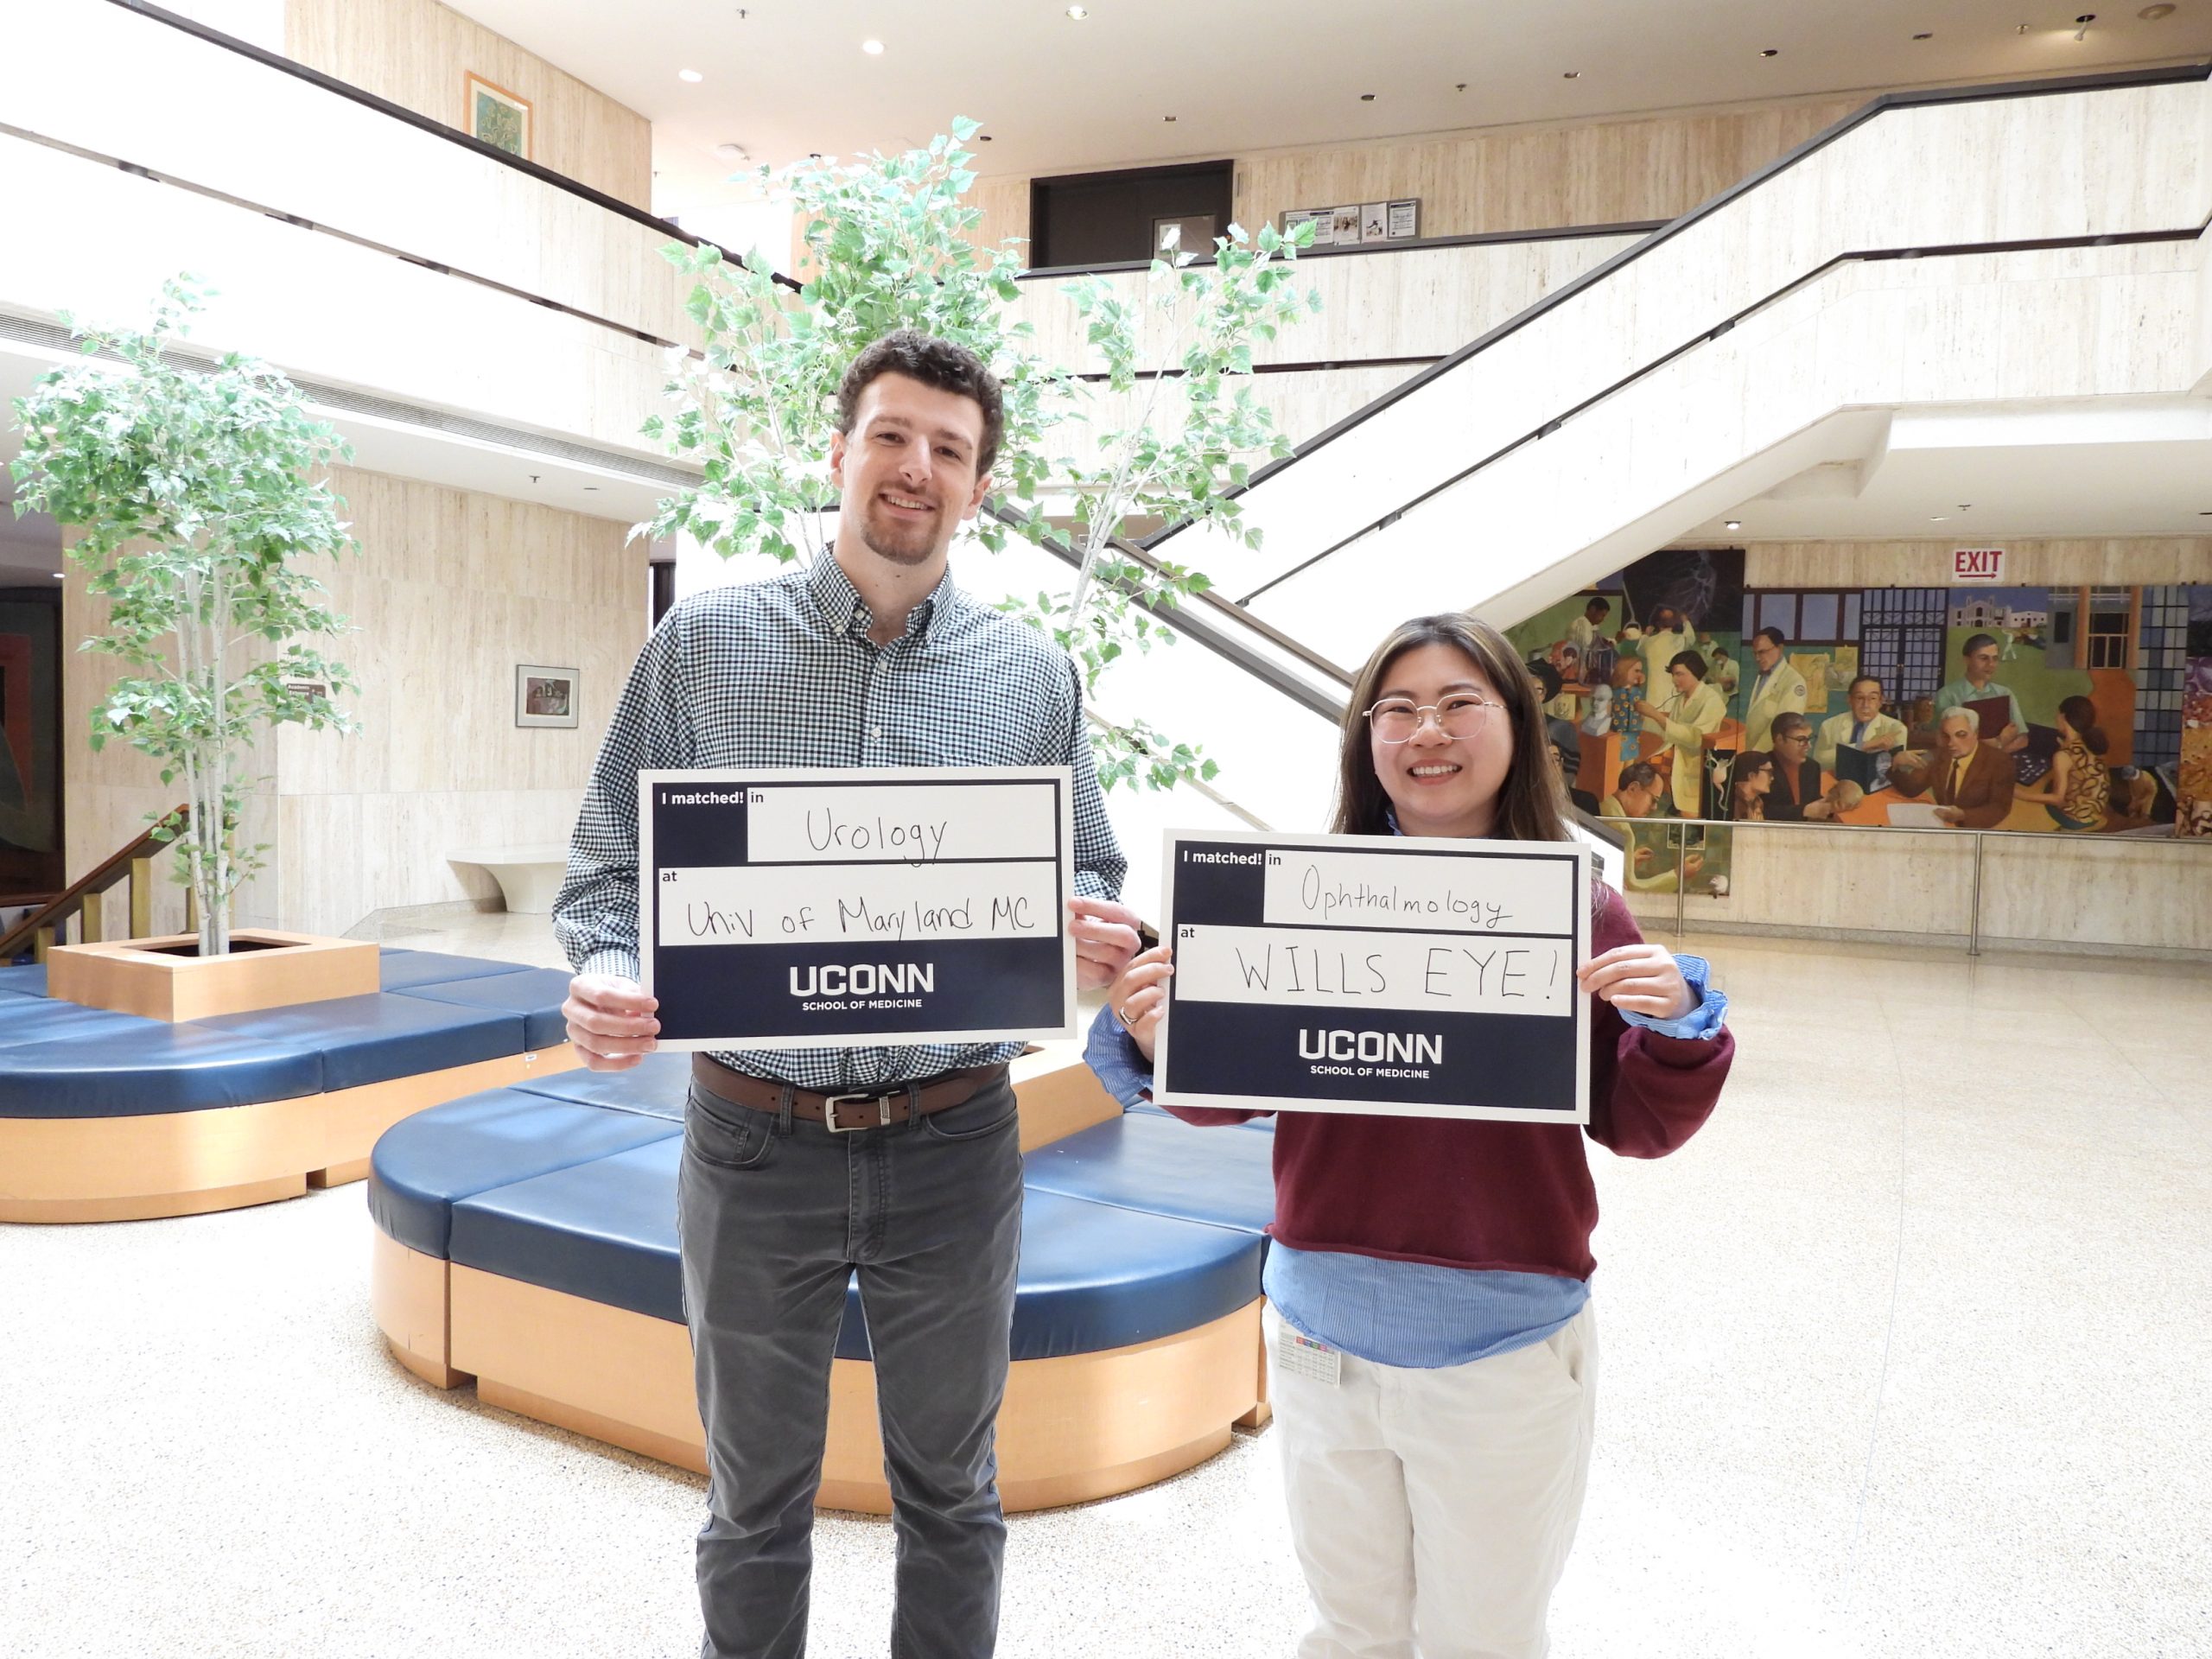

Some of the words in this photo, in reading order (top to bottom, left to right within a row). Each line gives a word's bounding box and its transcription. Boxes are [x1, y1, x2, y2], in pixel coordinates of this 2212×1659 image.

[1955, 550, 2003, 572] EXIT
[662, 792, 666, 804] I
[671, 791, 744, 804] matched!
[750, 791, 764, 804] in
[807, 808, 948, 868] Urology
[1183, 850, 1188, 862] I
[1192, 850, 1262, 866] matched!
[1268, 853, 1281, 866] in
[662, 870, 677, 882] at
[1301, 865, 1513, 928] Ophthalmology
[688, 900, 754, 938] Univ
[781, 906, 815, 933] of
[838, 896, 973, 942] Maryland
[991, 896, 1035, 931] MC
[1180, 927, 1195, 938] at
[789, 963, 934, 997] UCONN
[1236, 944, 1387, 995] WILLS
[1424, 948, 1558, 1000] EYE!
[802, 1001, 848, 1011] SCHOOL
[849, 1000, 867, 1010] OF
[868, 999, 923, 1010] MEDICINE
[1298, 1028, 1443, 1065] UCONN
[1310, 1065, 1355, 1077] SCHOOL
[1357, 1066, 1373, 1077] OF
[1376, 1067, 1430, 1079] MEDICINE
